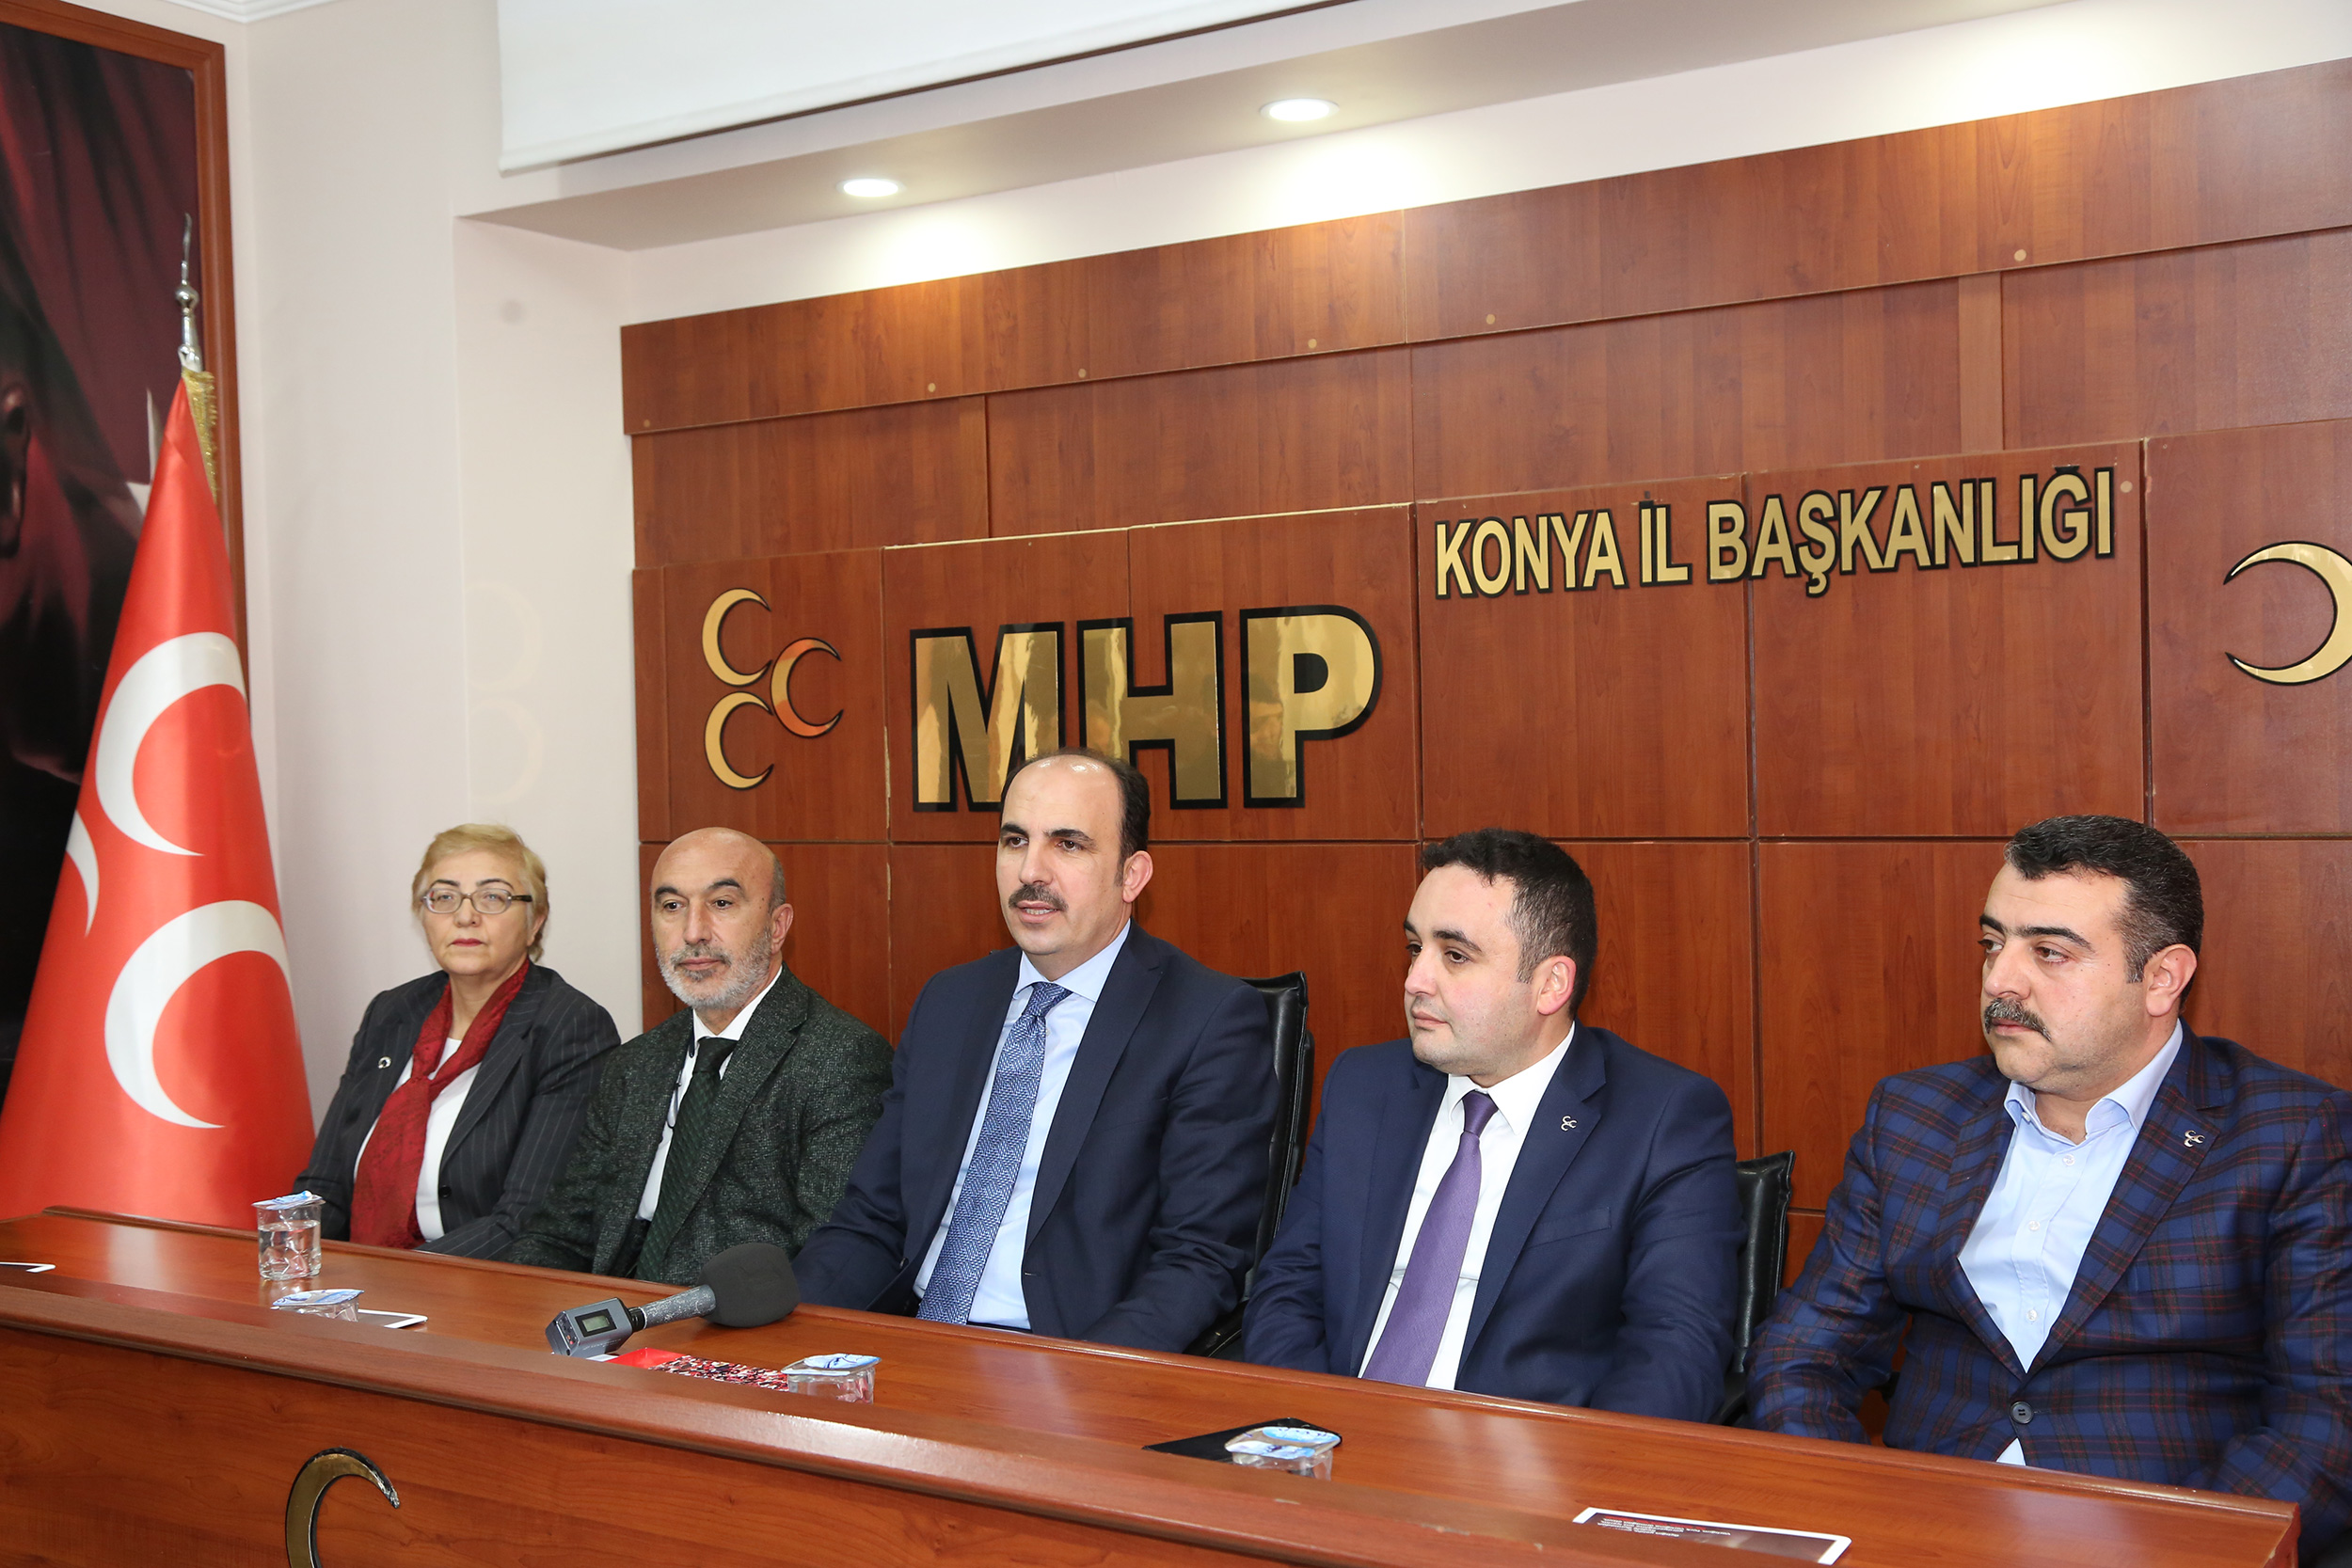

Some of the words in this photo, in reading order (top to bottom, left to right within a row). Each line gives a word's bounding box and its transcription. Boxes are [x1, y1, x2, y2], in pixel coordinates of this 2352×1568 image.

[1435, 509, 1629, 599] KONYA
[1638, 492, 1692, 587] İL
[1705, 466, 2115, 598] BAŞKANLIĞI
[910, 604, 1383, 813] MHP
